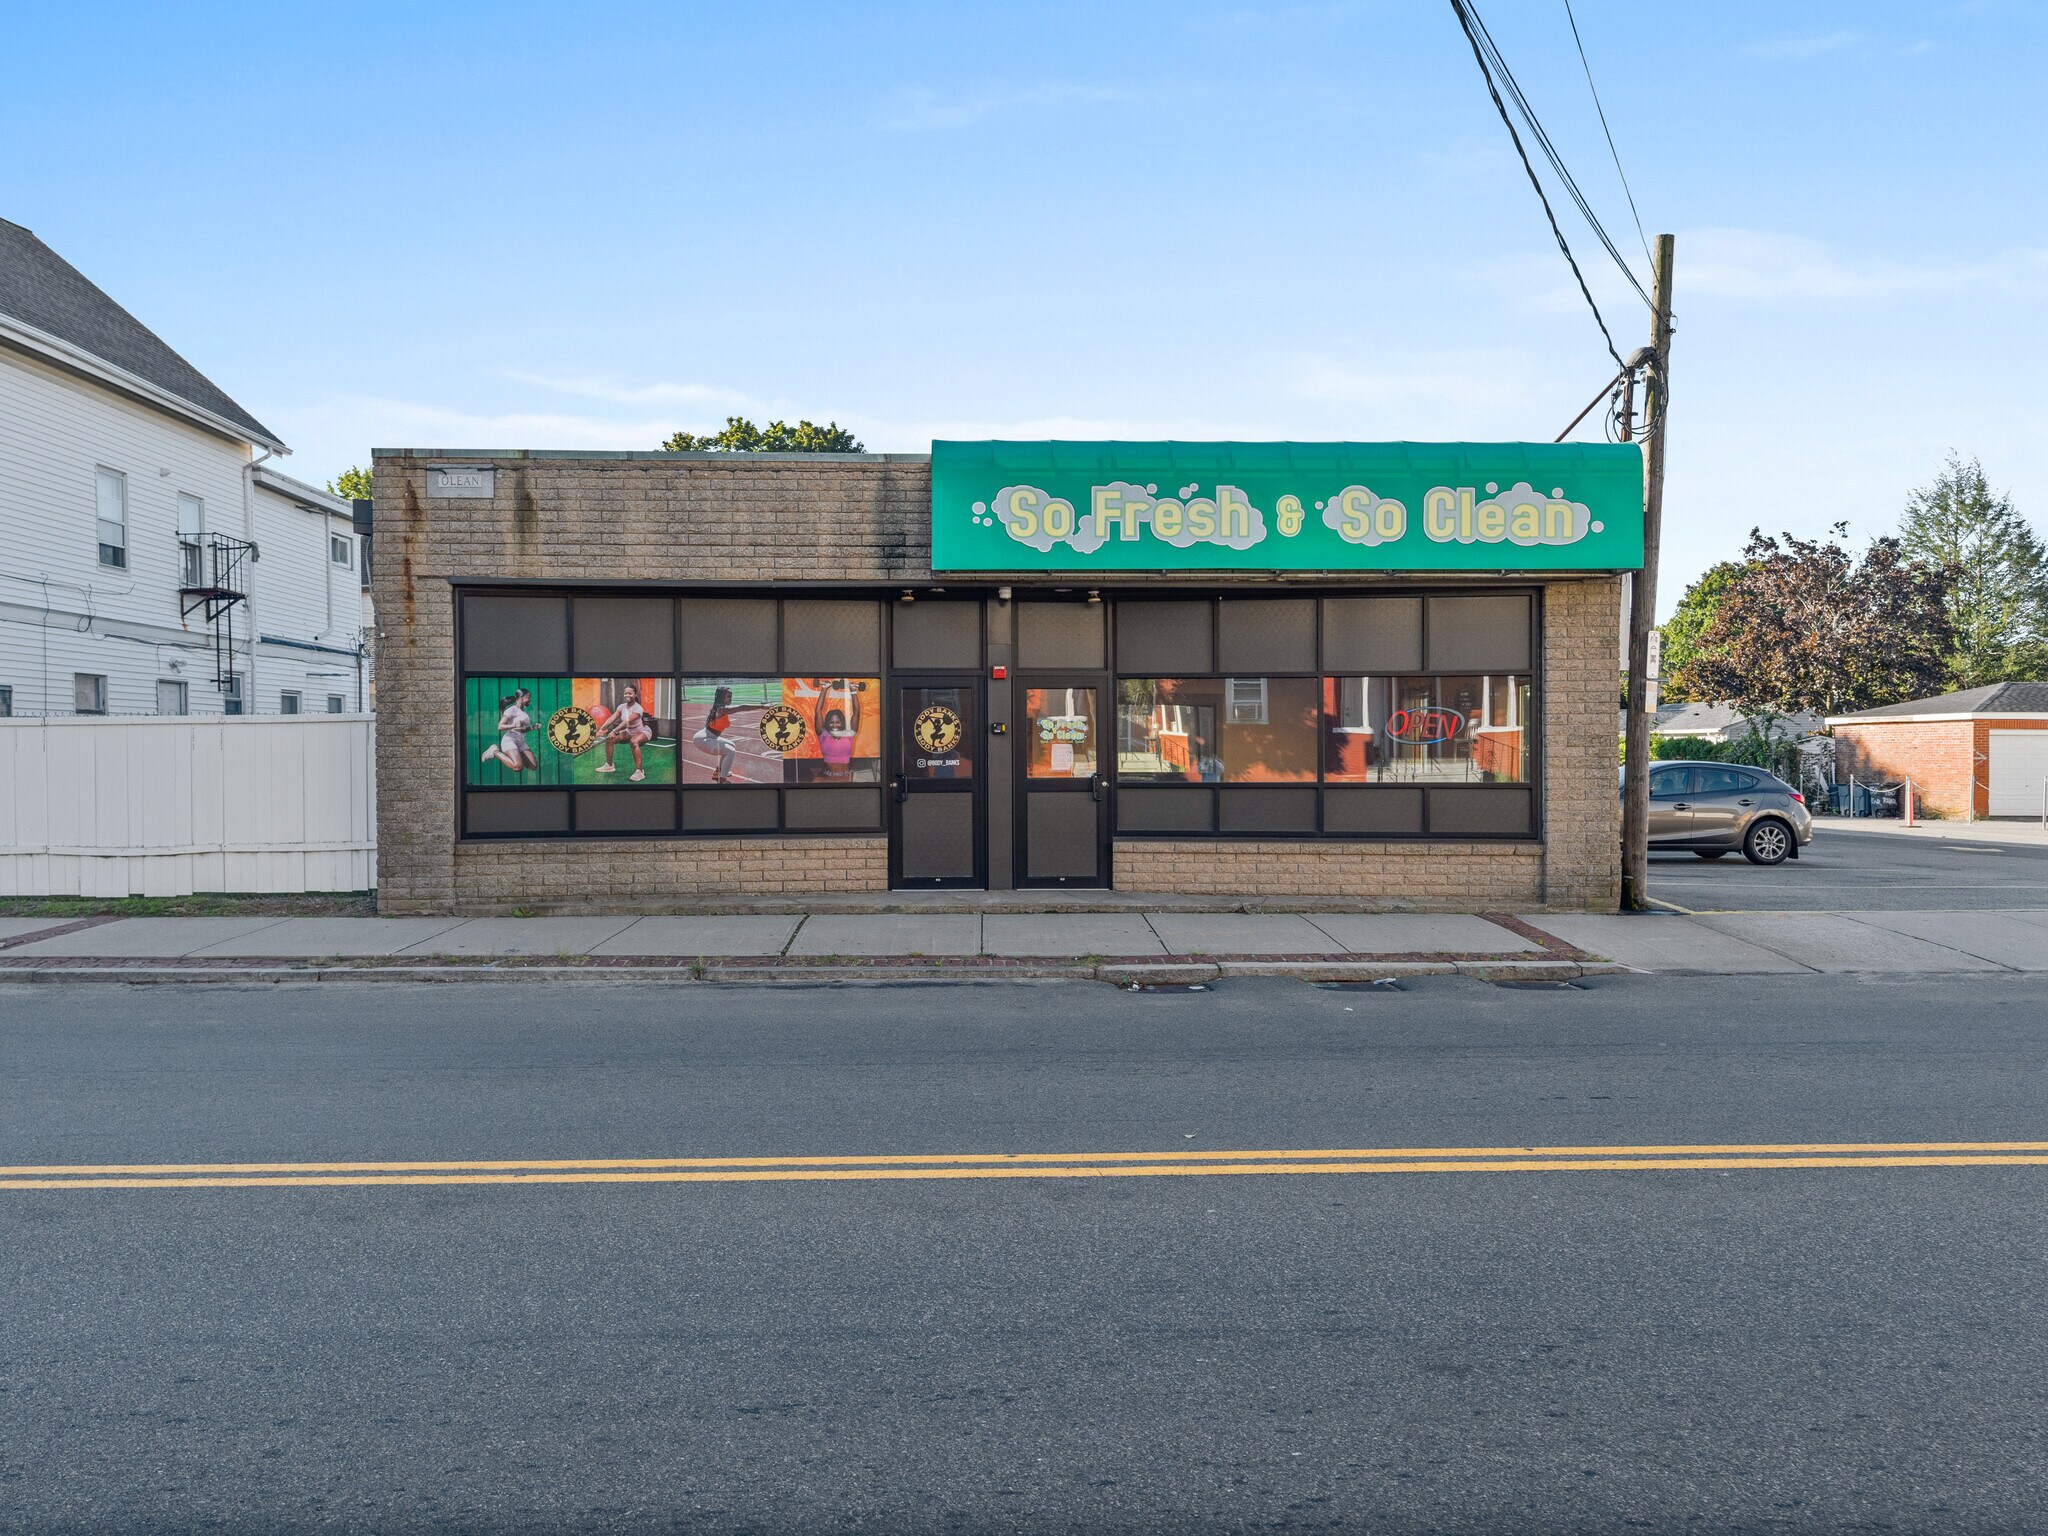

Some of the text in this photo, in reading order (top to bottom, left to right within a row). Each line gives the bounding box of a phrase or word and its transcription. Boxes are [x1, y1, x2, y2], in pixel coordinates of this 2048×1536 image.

[441, 475, 479, 486] OLEAN
[1009, 489, 1575, 539] So Fresh & So Clean
[551, 708, 595, 725] BODY BANKS
[762, 707, 803, 723] BODY BANKS
[917, 708, 959, 725] BODY BANKS
[1388, 710, 1458, 740] OPEN
[551, 736, 595, 752] BODY BANKS
[762, 734, 804, 751] BODY BANKS
[918, 735, 960, 752] BODY BANKS
